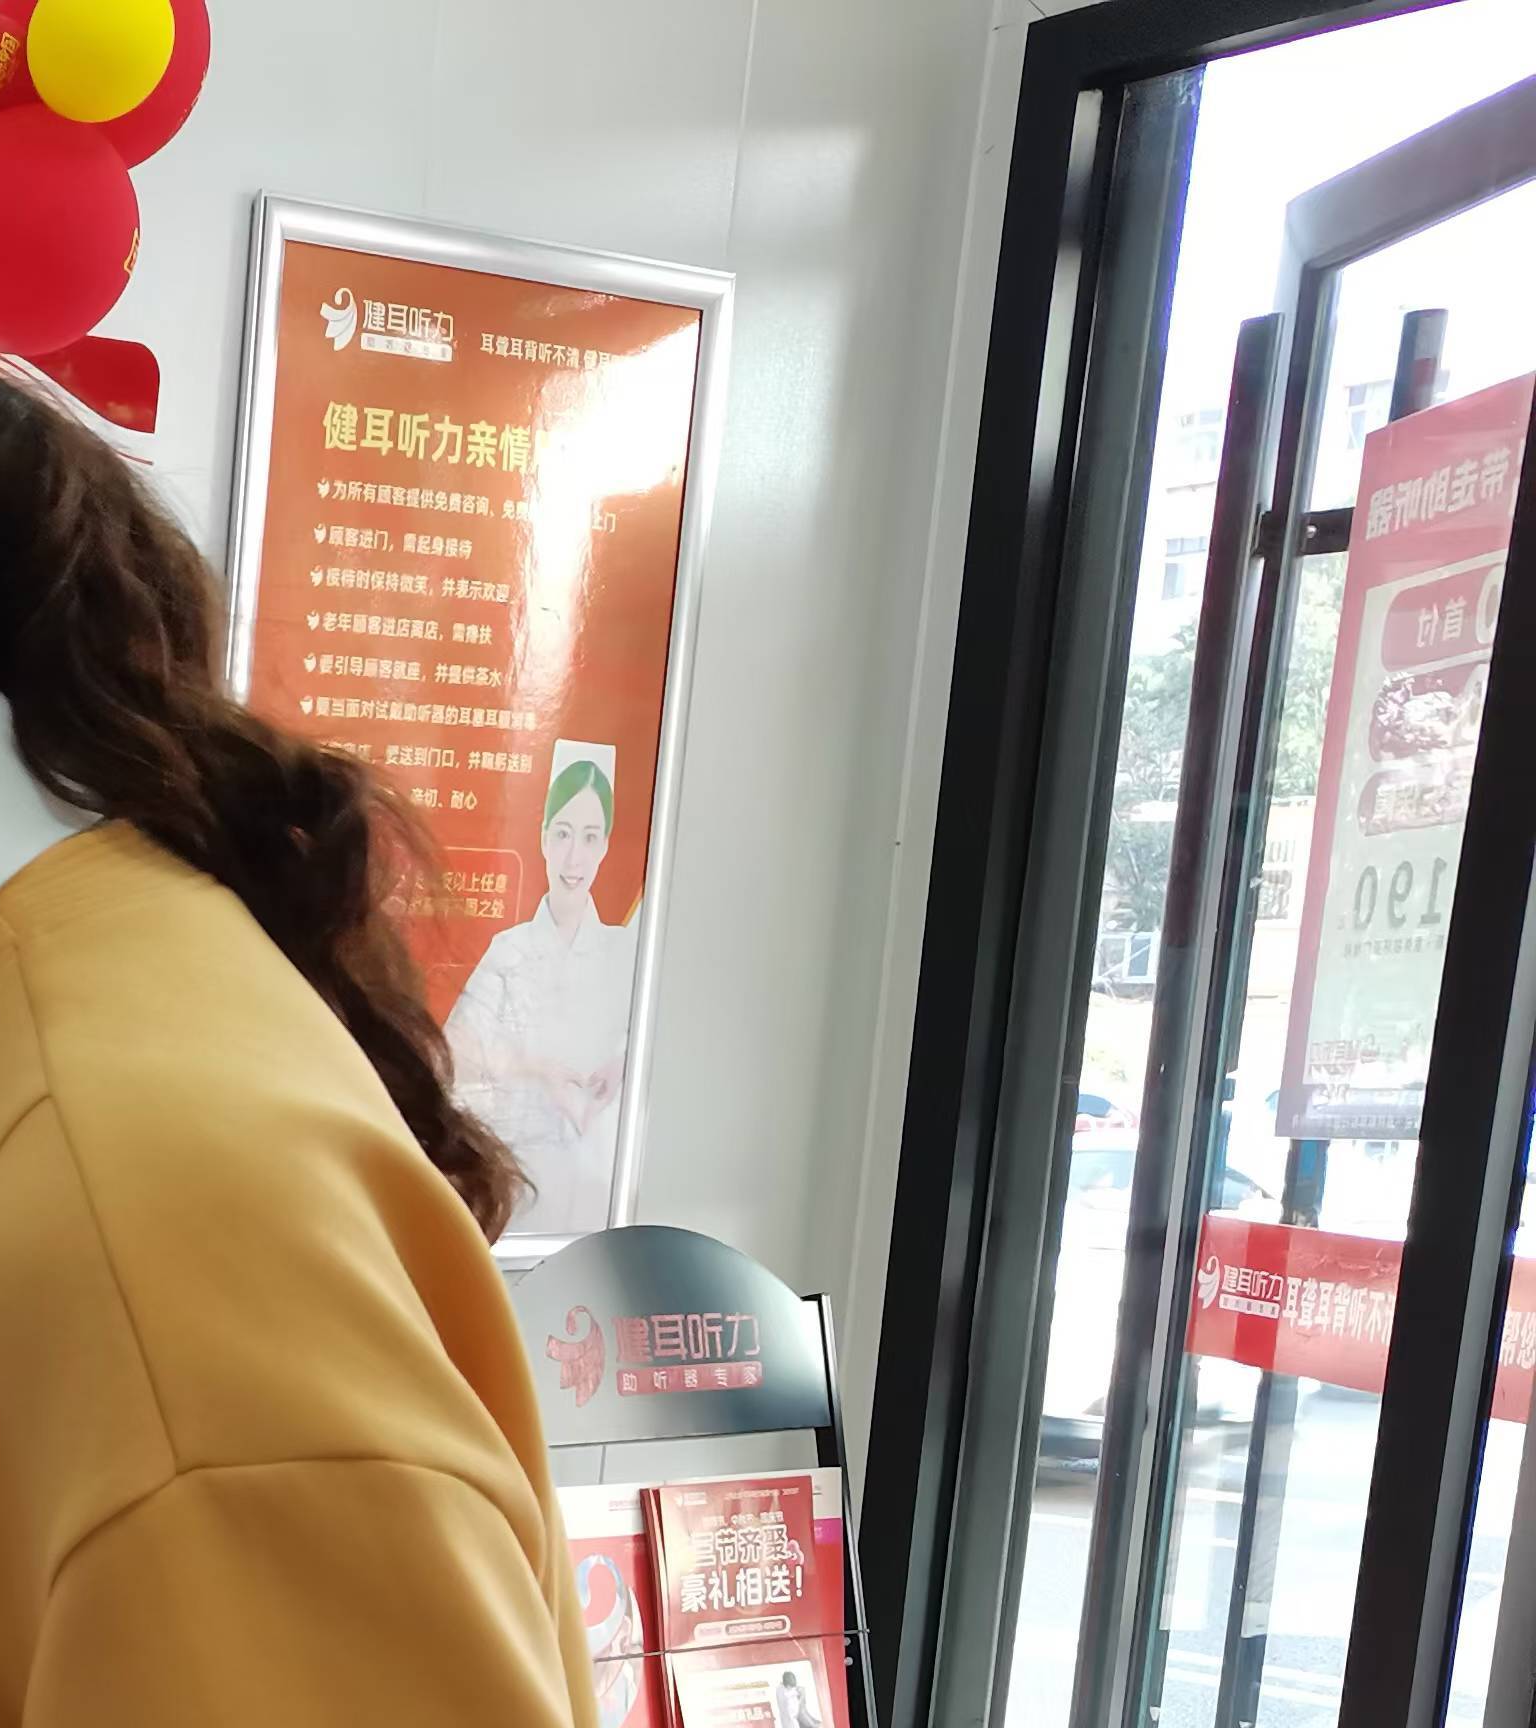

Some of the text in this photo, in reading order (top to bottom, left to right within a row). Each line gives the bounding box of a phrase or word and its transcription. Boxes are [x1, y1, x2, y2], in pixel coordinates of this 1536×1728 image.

[363, 299, 454, 343] 健耳听力
[322, 400, 546, 479] 健耳听力亲情
[611, 1312, 761, 1363] 健耳听力
[622, 1364, 758, 1393] 助听器专家
[680, 1564, 804, 1614] 豪礼相送!
